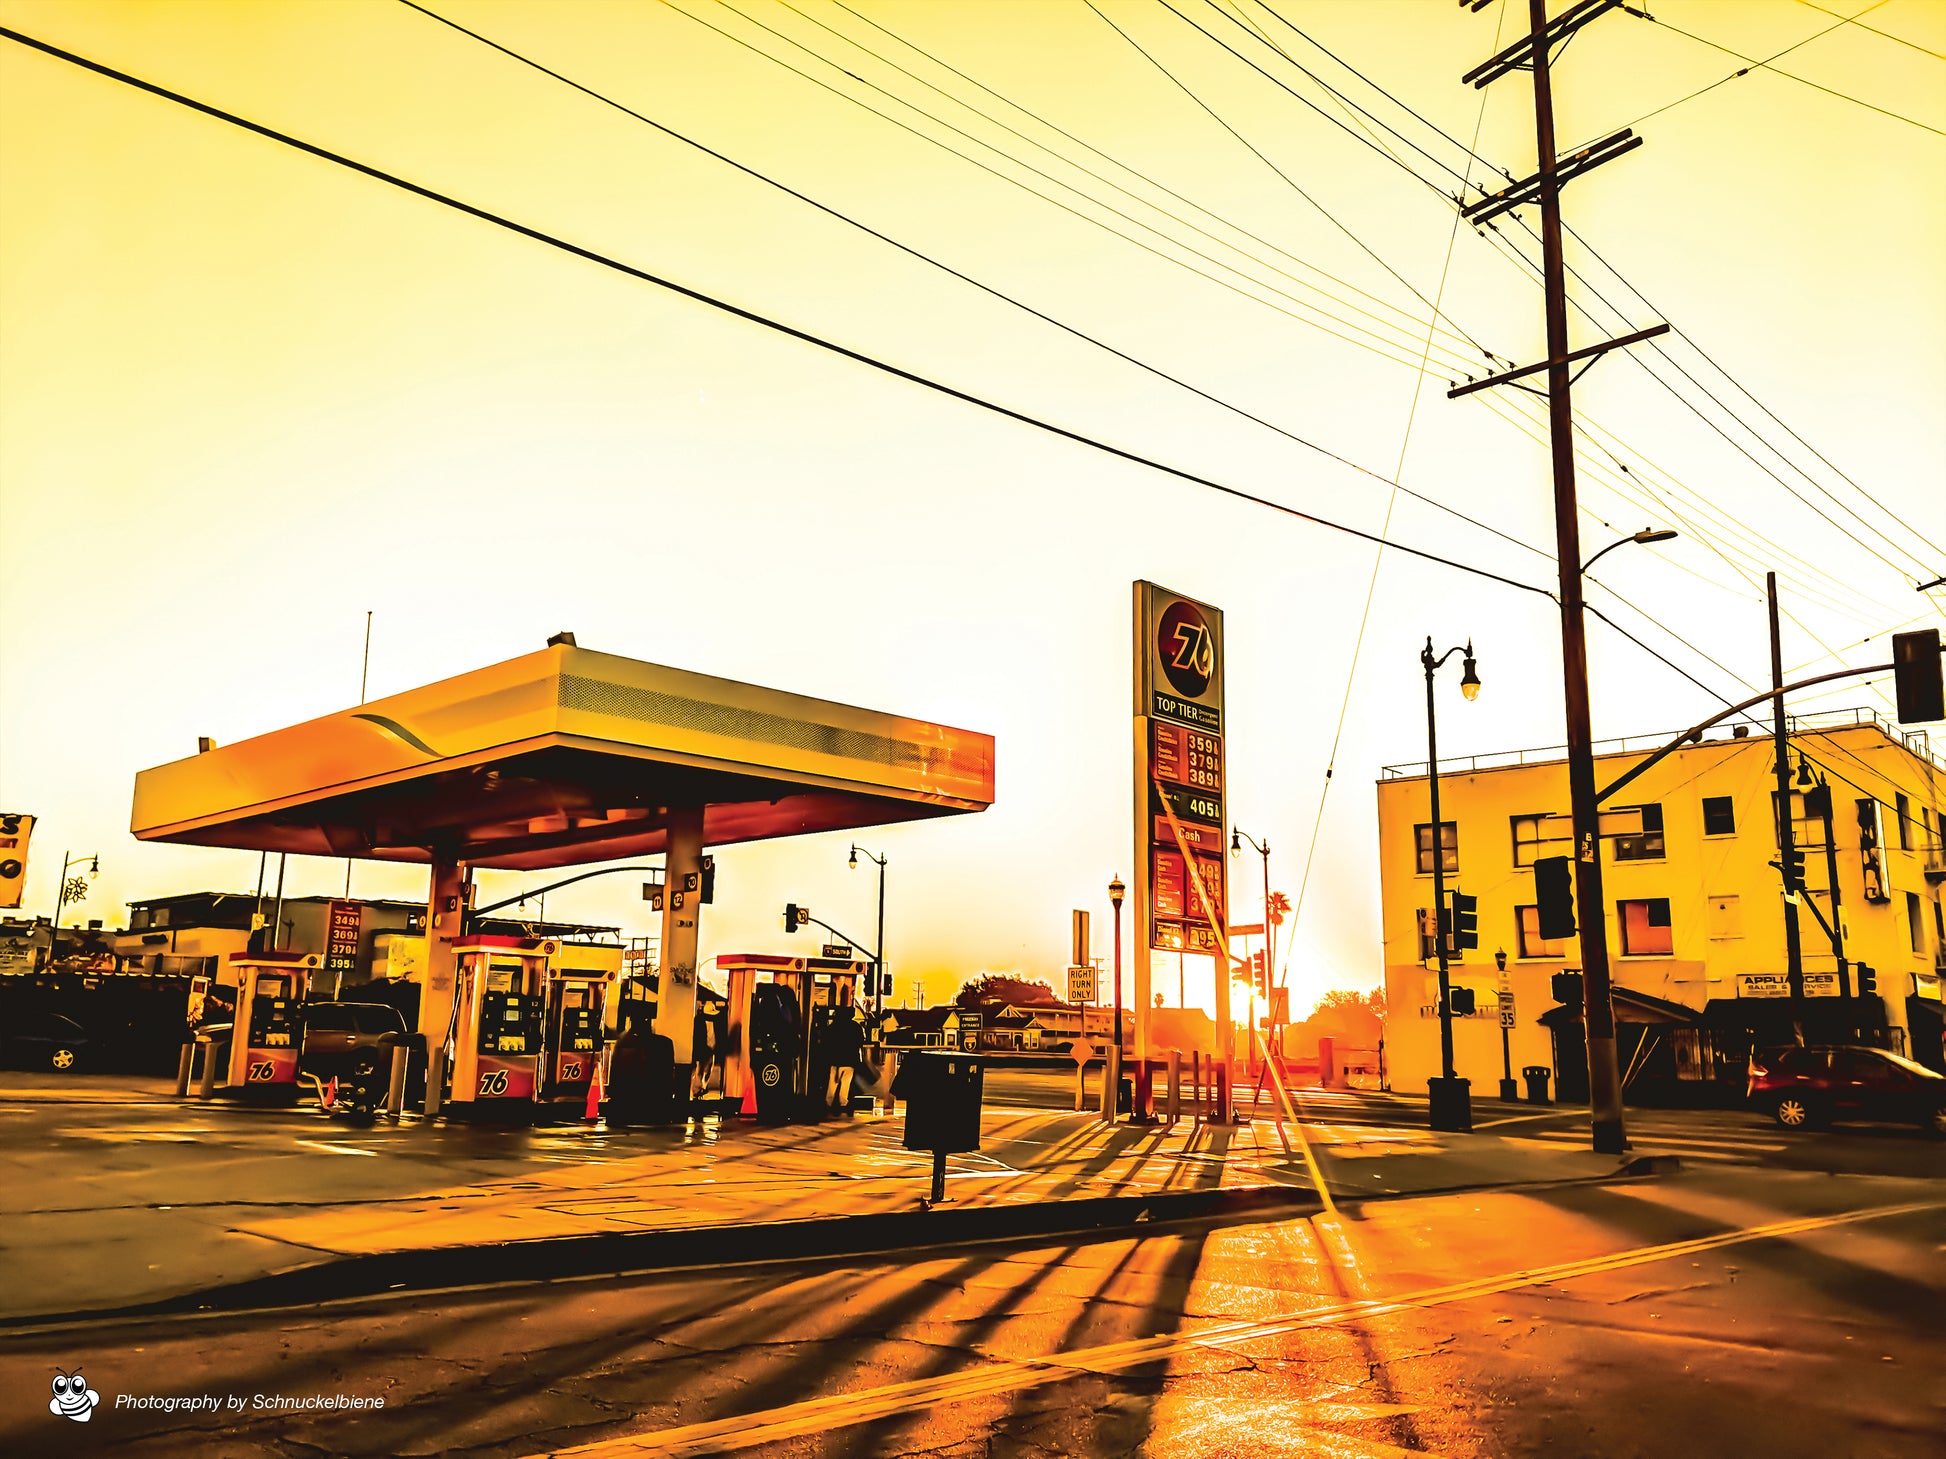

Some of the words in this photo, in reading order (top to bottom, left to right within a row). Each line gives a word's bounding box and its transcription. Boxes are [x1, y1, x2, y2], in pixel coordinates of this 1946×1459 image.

[1171, 622, 1214, 679] 76
[1156, 696, 1176, 713] TOP
[1177, 702, 1198, 720] TIER
[1178, 826, 1201, 842] Cash
[1070, 970, 1092, 978] RIGHT
[1744, 975, 1834, 985] APPLICES
[1072, 980, 1091, 988] TURN
[1071, 990, 1091, 999] ONLY
[1501, 1012, 1515, 1026] 35
[249, 1061, 275, 1081] 76
[562, 1062, 582, 1080] 76
[764, 1069, 780, 1083] 76
[479, 1070, 508, 1095] 76
